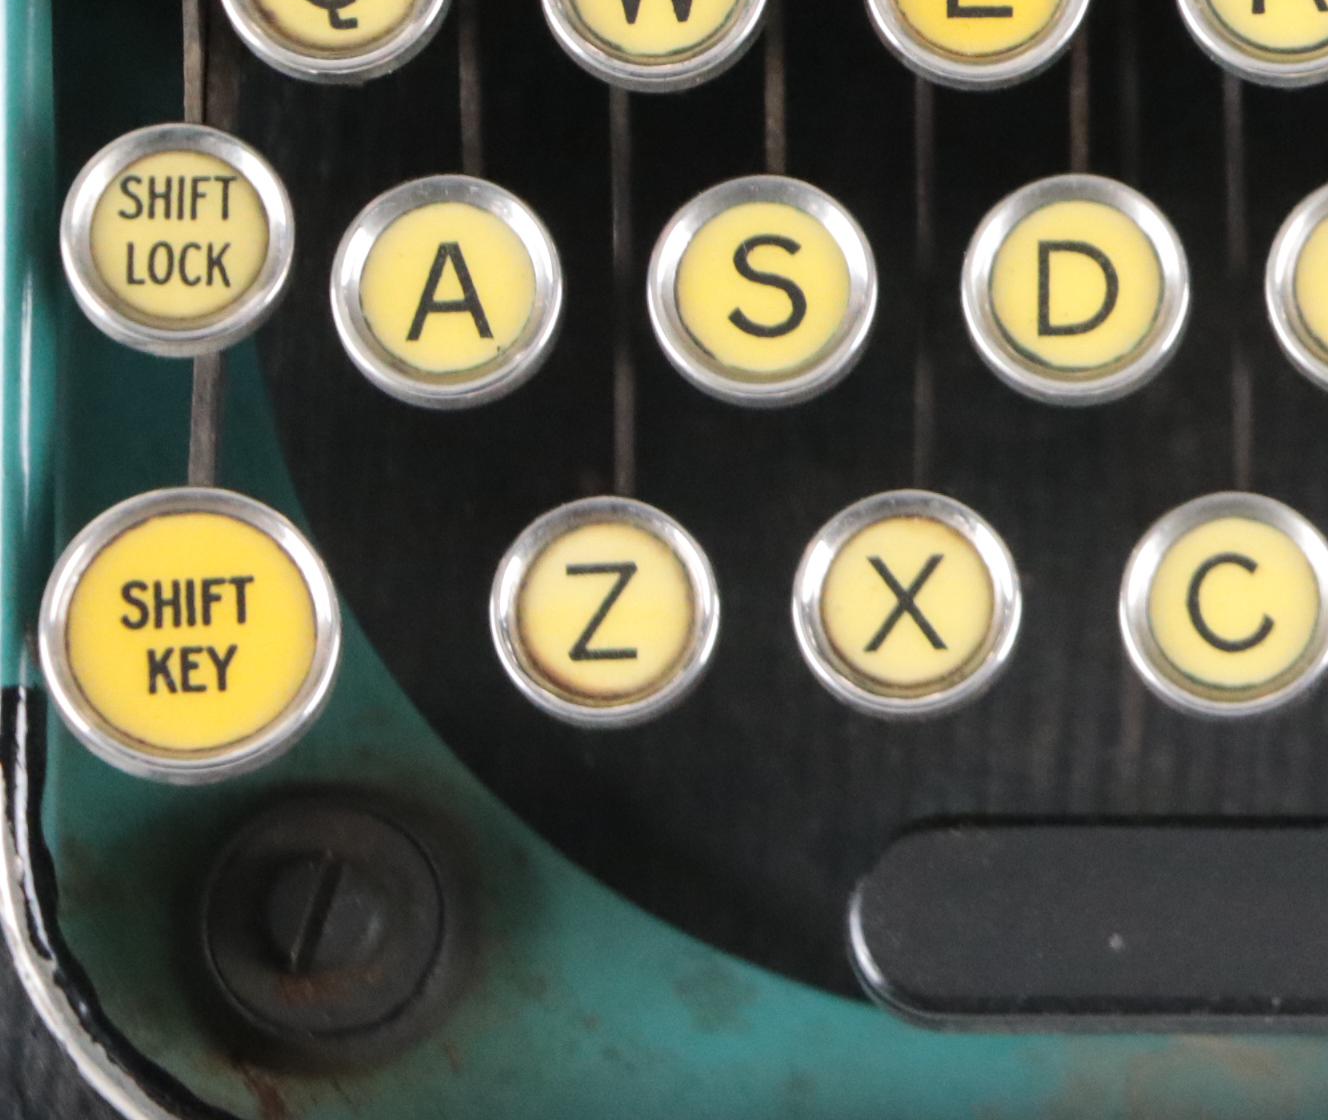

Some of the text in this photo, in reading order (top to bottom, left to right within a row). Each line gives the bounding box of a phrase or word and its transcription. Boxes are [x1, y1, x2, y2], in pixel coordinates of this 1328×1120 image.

[119, 175, 235, 221] SHIFT
[126, 241, 231, 288] LOCK
[406, 243, 494, 341] A
[728, 235, 807, 338] S
[1037, 240, 1119, 337] D
[121, 576, 254, 630] SHIFT
[566, 563, 637, 662] Z
[865, 555, 946, 652] X
[1187, 554, 1274, 653] C
[147, 645, 238, 695] KEY
